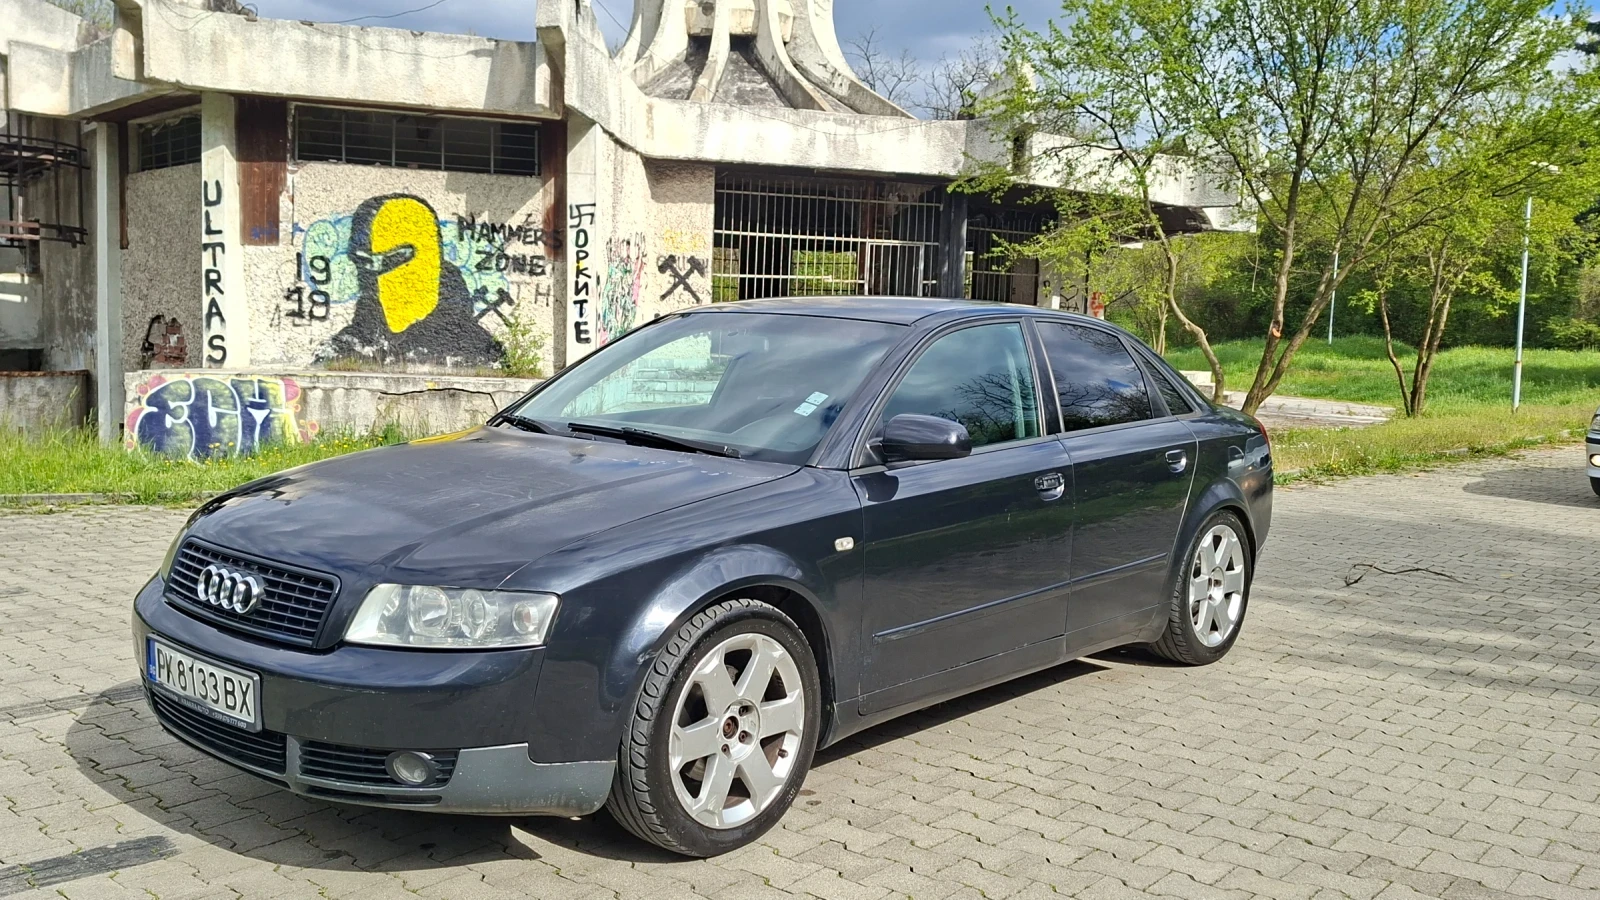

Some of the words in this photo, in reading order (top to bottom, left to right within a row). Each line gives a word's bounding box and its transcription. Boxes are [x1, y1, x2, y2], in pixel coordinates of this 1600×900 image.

[456, 212, 563, 249] HAMMERS
[203, 179, 227, 364] ULTRAS
[475, 248, 546, 277] ZONE
[177, 659, 220, 705] 8133
[223, 675, 251, 717] BX
